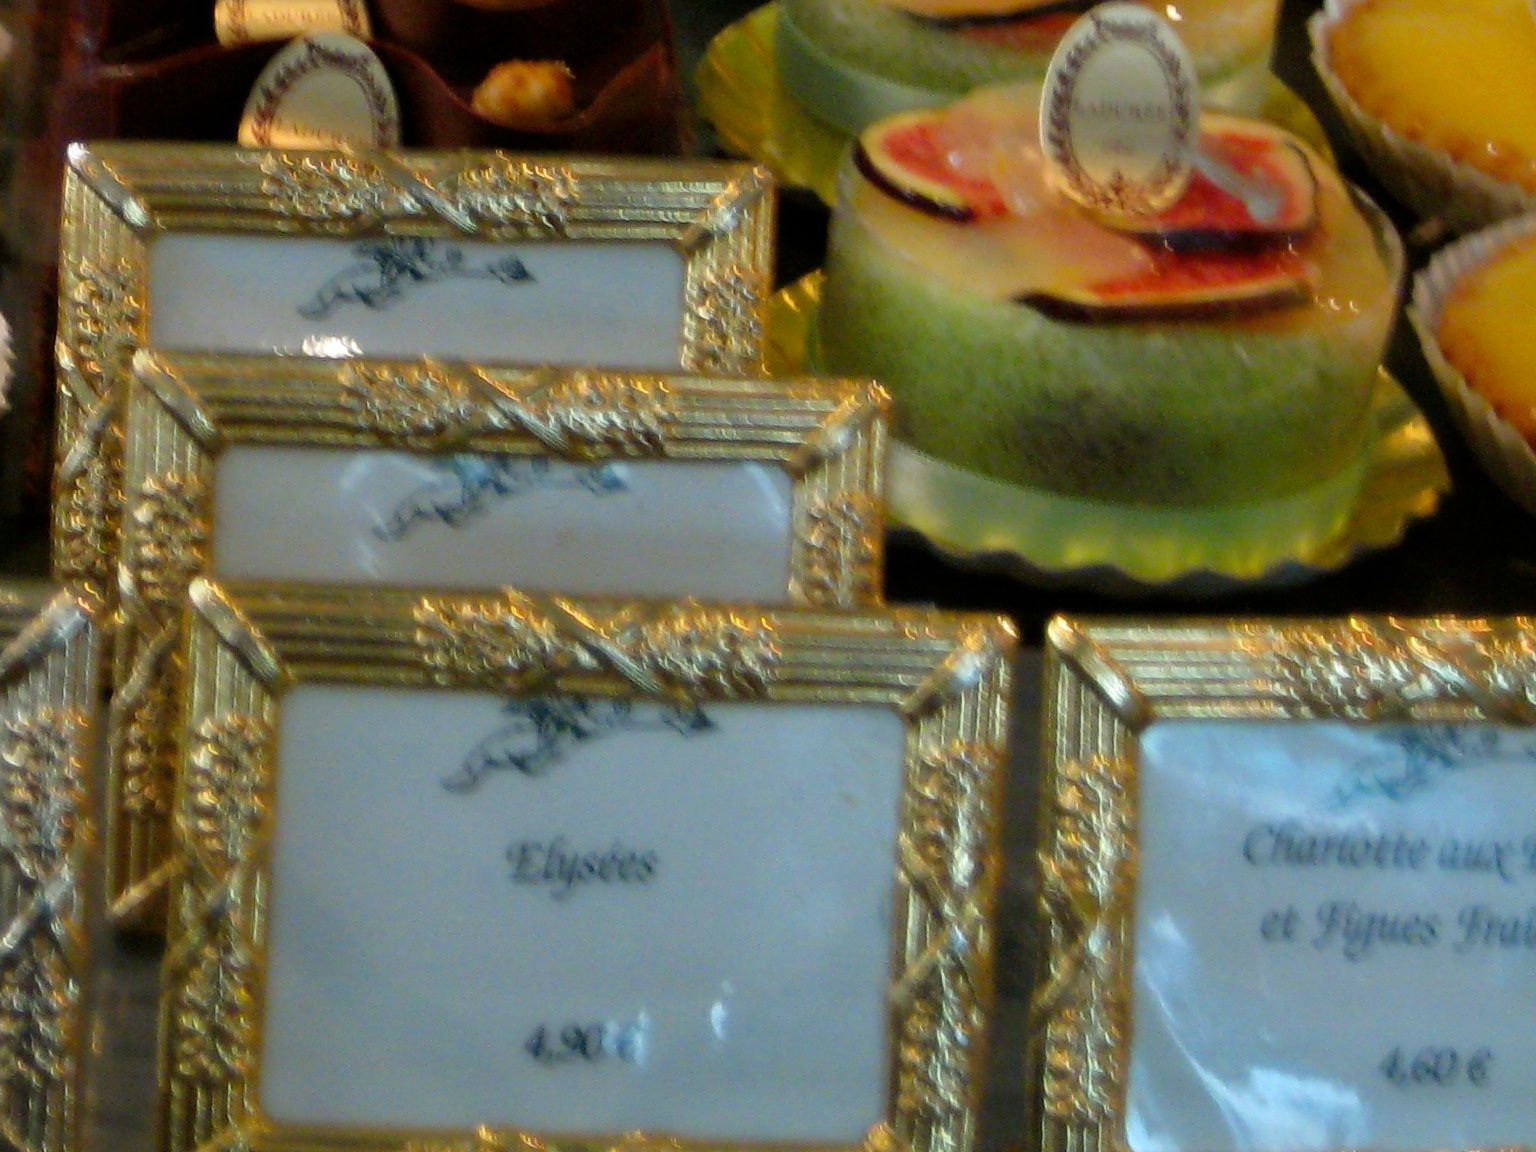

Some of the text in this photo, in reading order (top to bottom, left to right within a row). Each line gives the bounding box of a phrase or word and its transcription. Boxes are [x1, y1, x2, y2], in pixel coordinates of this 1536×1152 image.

[1243, 821, 1429, 869] Charlotte
[1438, 837, 1514, 882] aux
[1261, 904, 1299, 942] et
